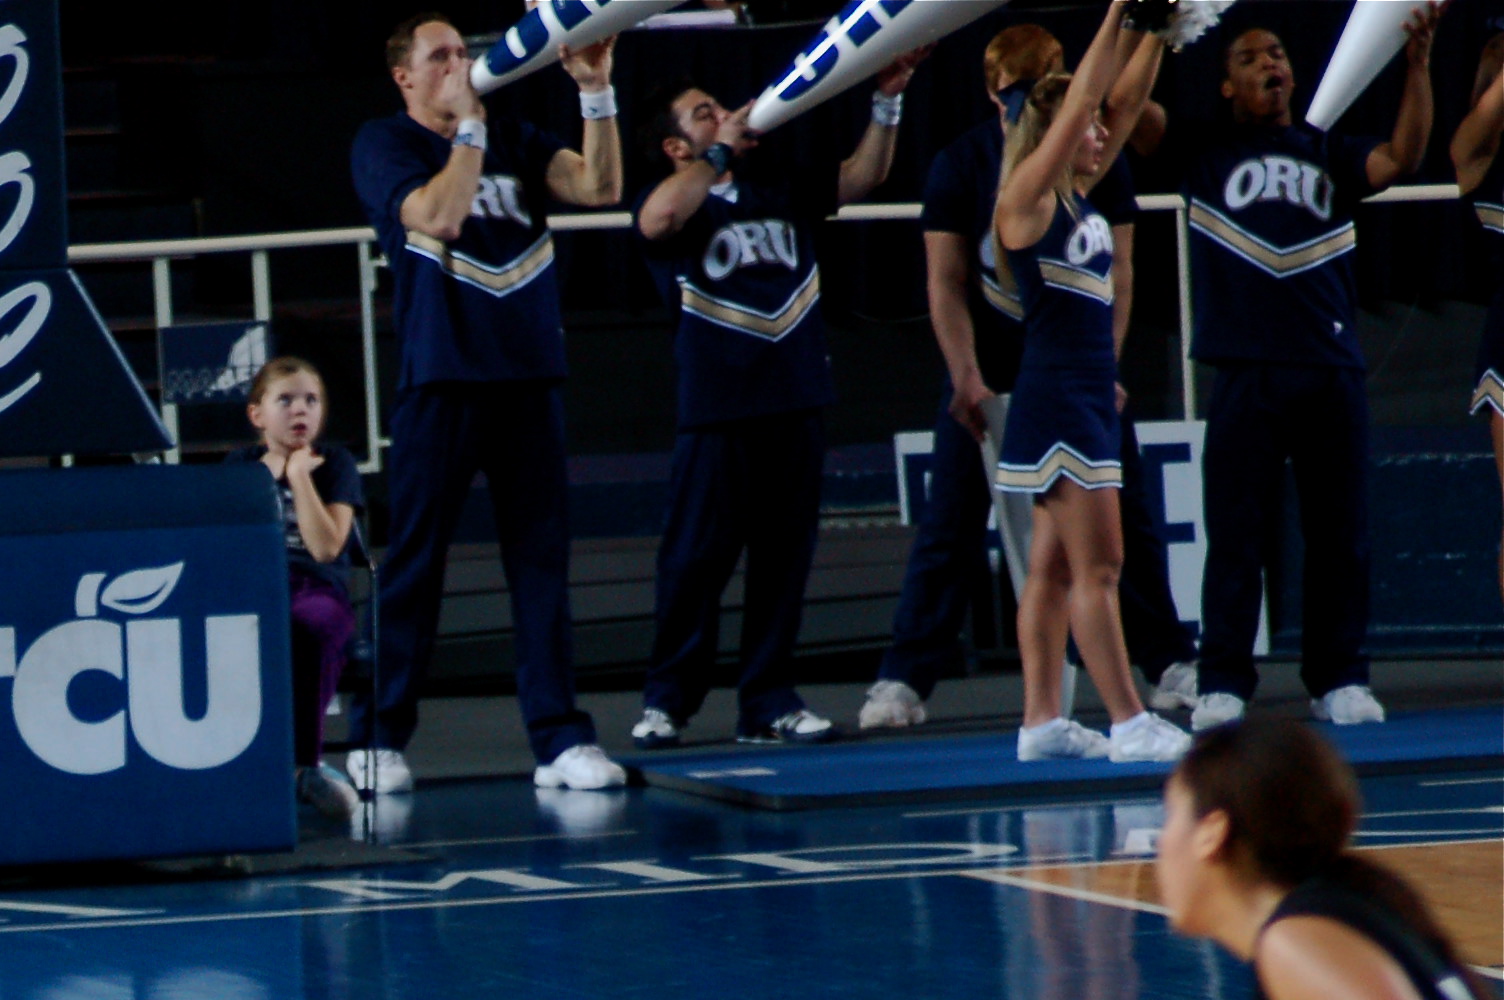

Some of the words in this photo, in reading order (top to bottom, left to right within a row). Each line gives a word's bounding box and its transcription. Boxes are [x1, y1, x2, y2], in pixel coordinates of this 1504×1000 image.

[471, 174, 533, 228] RU
[1223, 155, 1334, 221] ORU
[702, 219, 798, 281] ORU
[1066, 213, 1114, 266] OR
